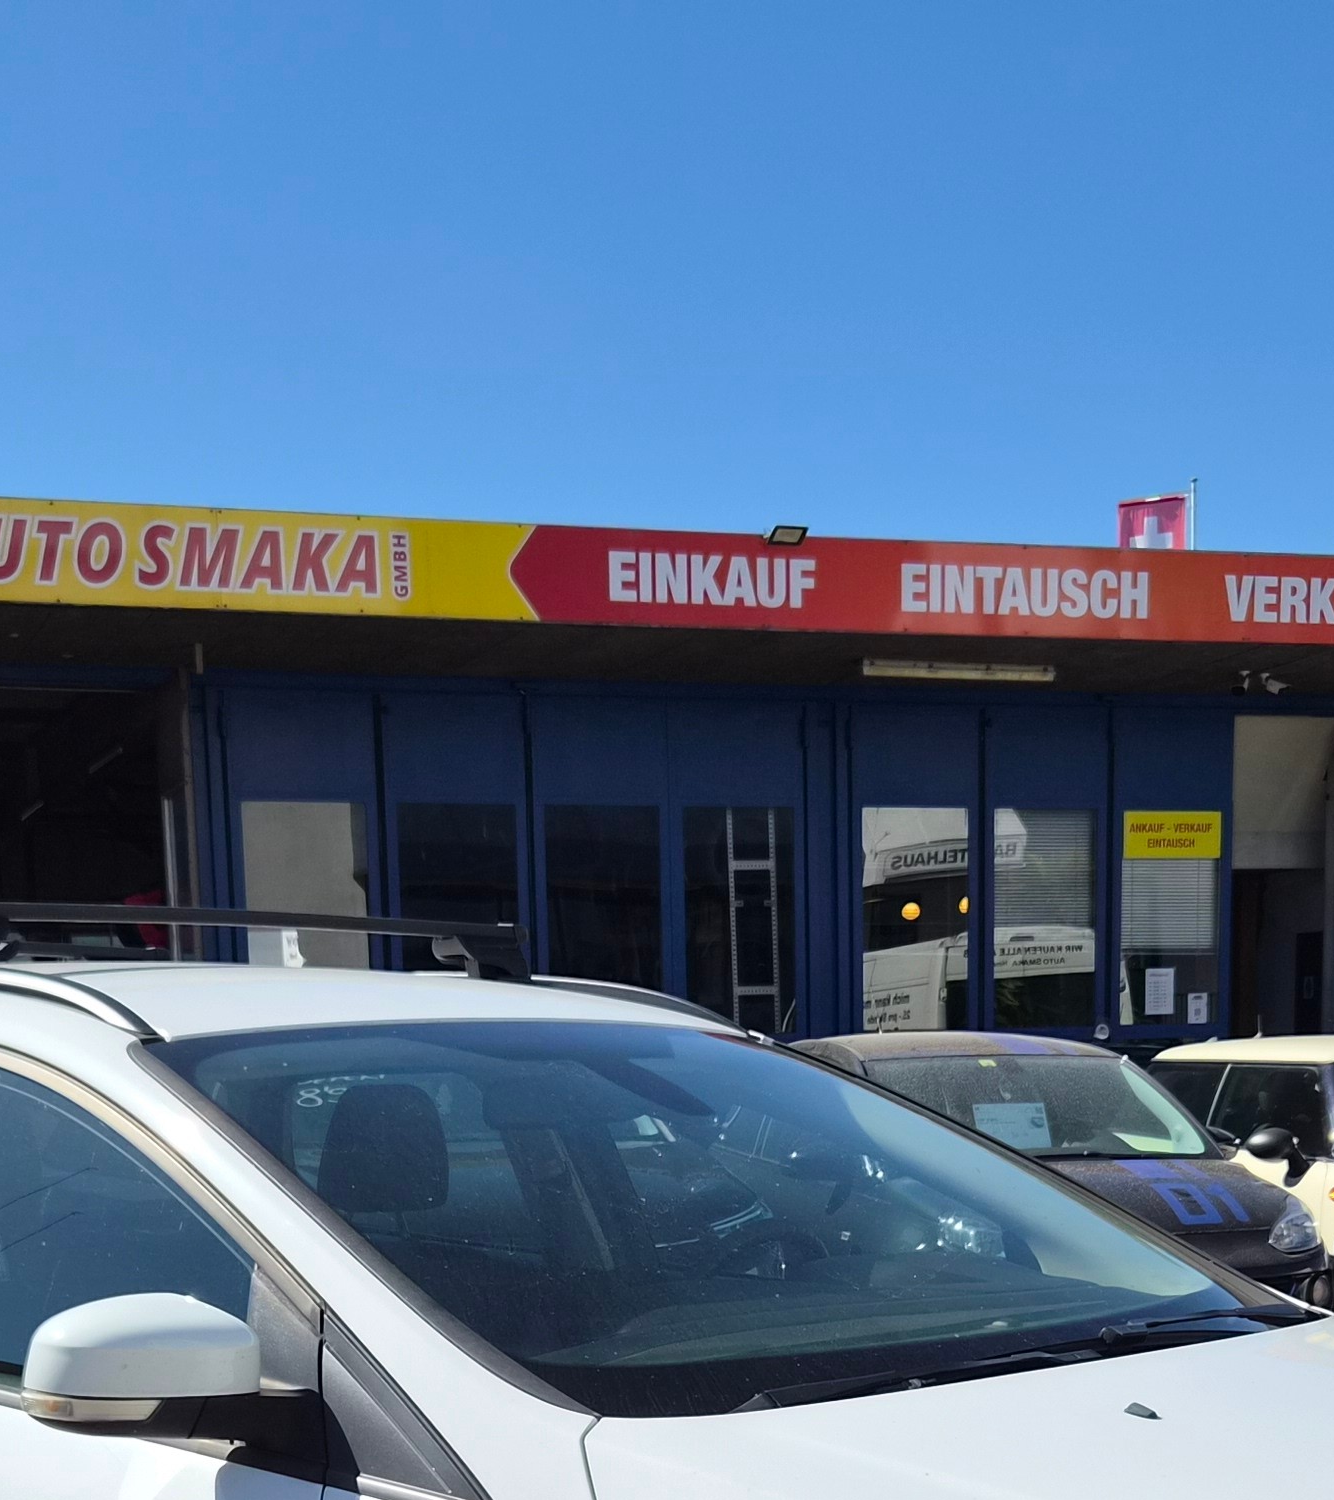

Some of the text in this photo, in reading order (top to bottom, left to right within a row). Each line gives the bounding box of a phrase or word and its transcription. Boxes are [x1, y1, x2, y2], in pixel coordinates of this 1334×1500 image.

[136, 522, 380, 596] SMAKA
[392, 534, 409, 598] GMBH
[607, 550, 817, 609] EINKAUF
[900, 563, 1150, 620] EINTAUSCH
[1129, 823, 1165, 833] ANKAUF
[1173, 823, 1212, 834] VERKAUF
[1147, 838, 1195, 849] EINTAUSCH
